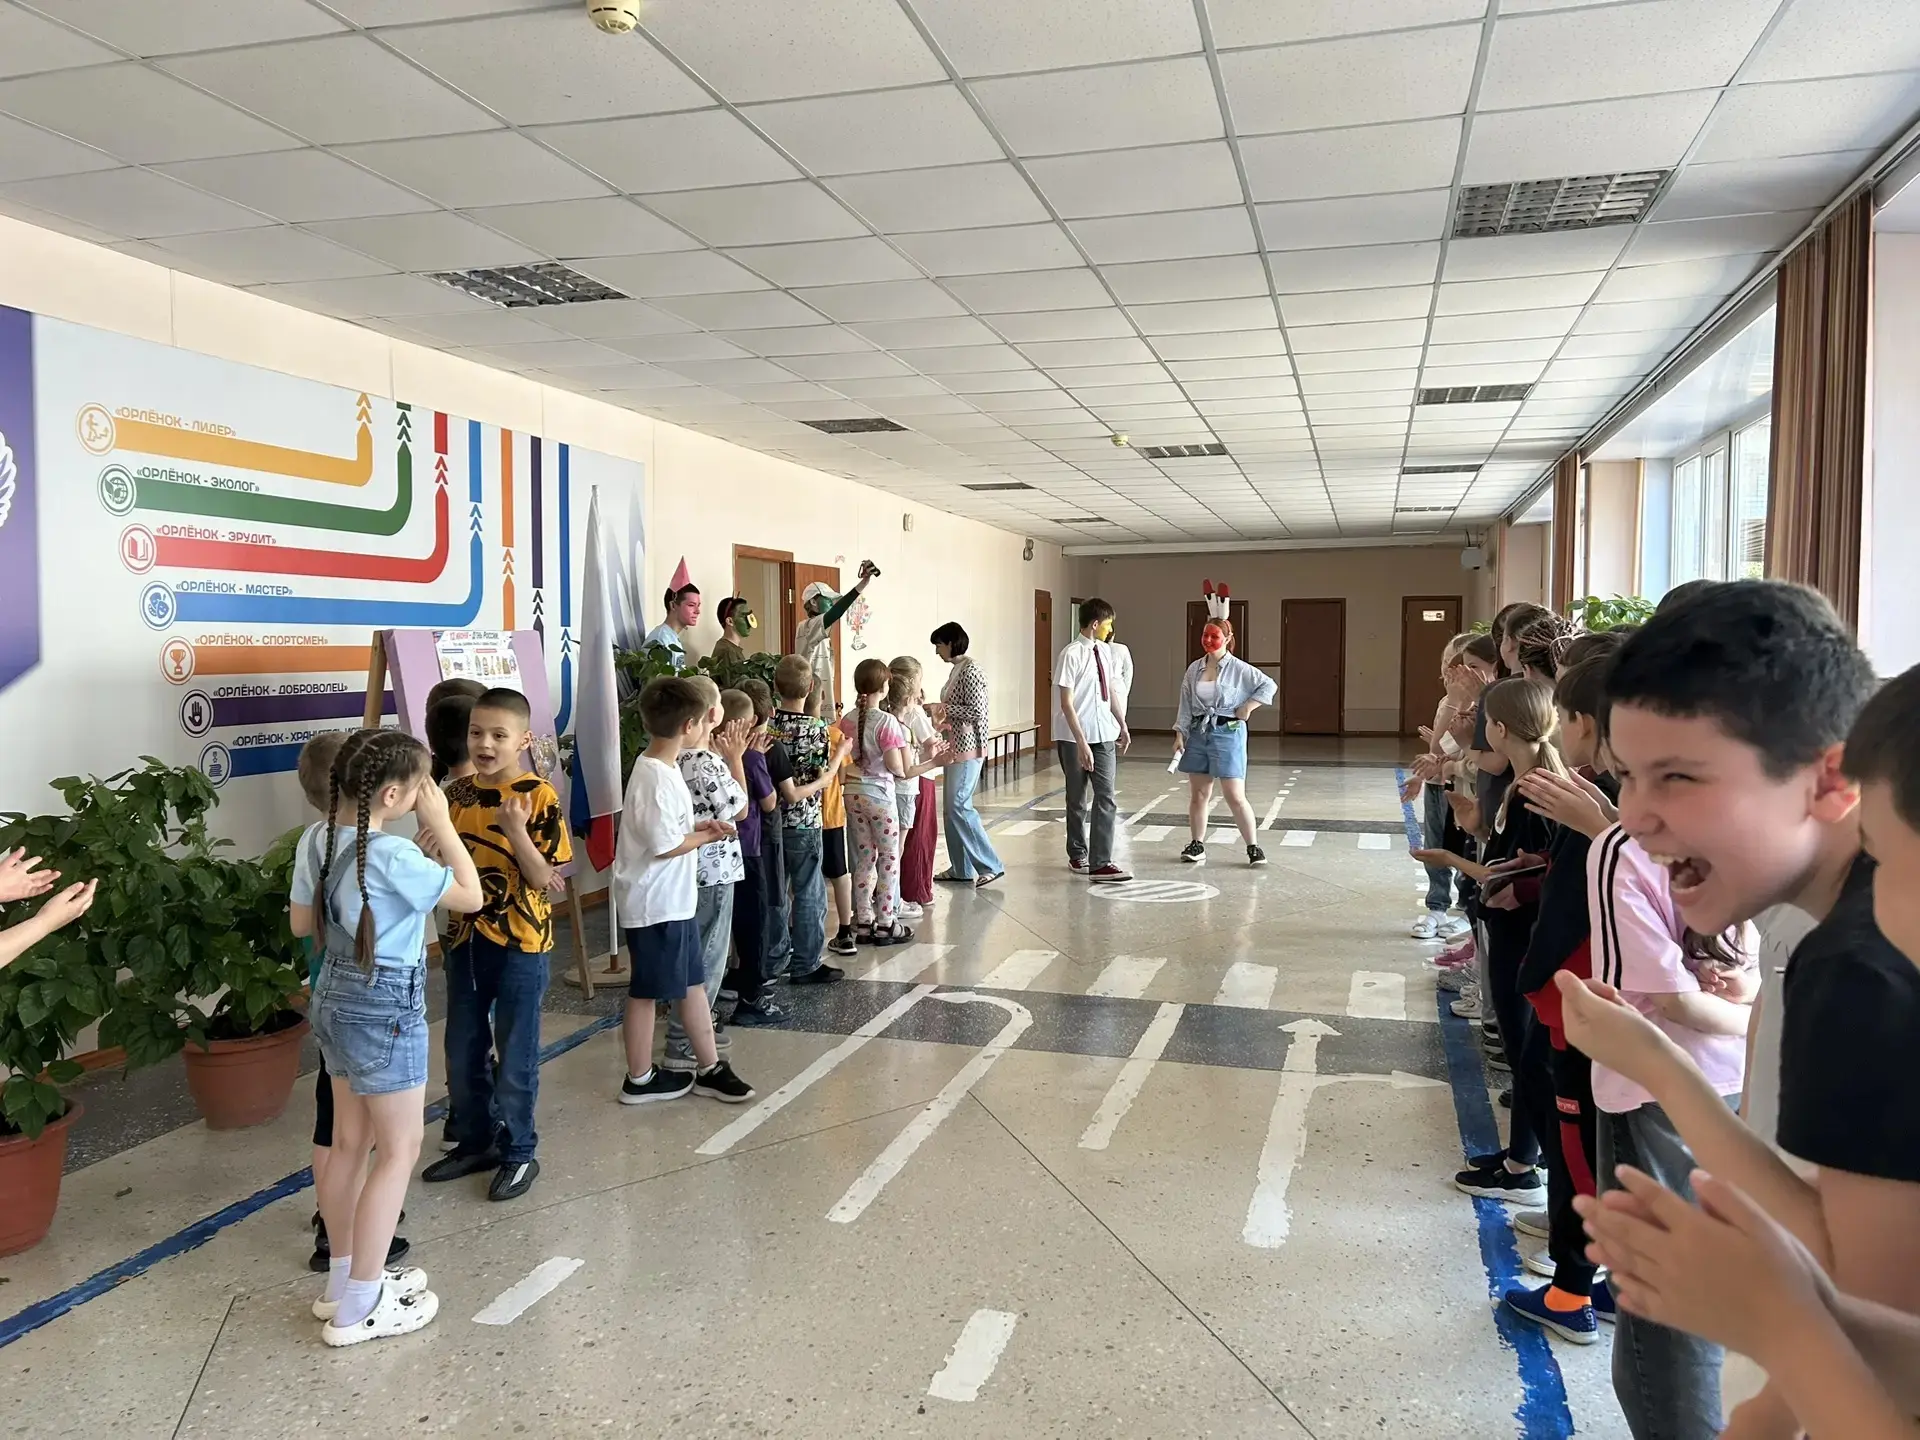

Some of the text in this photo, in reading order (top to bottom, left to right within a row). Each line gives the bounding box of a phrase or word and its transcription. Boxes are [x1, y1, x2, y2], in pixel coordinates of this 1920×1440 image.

[115, 406, 182, 428] «ОРЛЁНОК
[191, 420, 236, 438] ЛИДЕР»
[136, 467, 201, 485] «ОРЛЁНОК
[211, 476, 260, 493] ЭКОЛОГ»
[156, 525, 218, 540] «ОРЛЁНОК
[228, 532, 277, 545] ЭРУДИТ»
[176, 580, 236, 593] «ОРЛЁНОК
[246, 584, 293, 596] МАСТЕР»
[195, 632, 253, 645] «ОРЛЁНОК
[263, 635, 329, 645] СПОРТСМЕН»
[213, 684, 269, 698] «ОРЛЁНОК
[278, 683, 348, 695] ДОБРОВОЛЕЦ»
[232, 732, 284, 747] «ОРЛЁНОК
